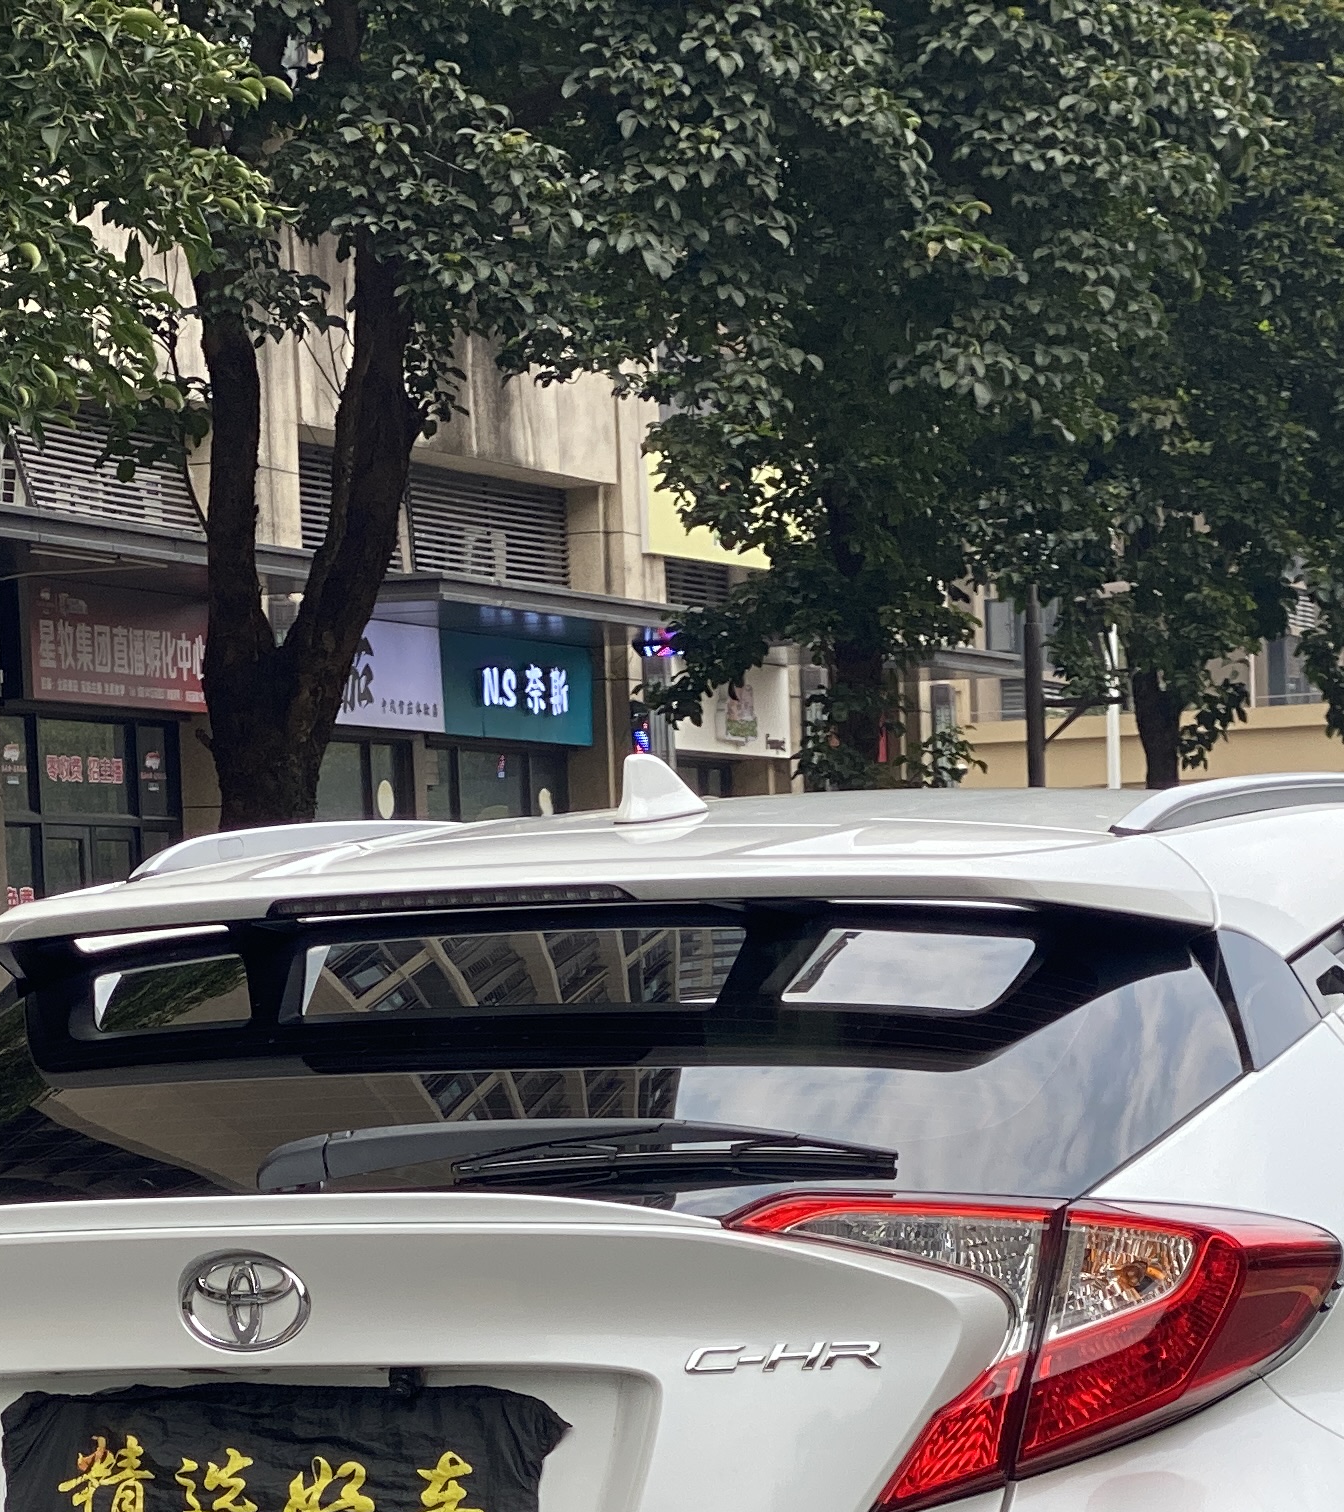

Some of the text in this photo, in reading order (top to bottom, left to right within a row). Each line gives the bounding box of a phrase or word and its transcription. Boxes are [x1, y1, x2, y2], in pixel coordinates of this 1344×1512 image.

[482, 666, 518, 708] N.S
[524, 663, 569, 716] 奈斯
[684, 1340, 882, 1375] C-HR
